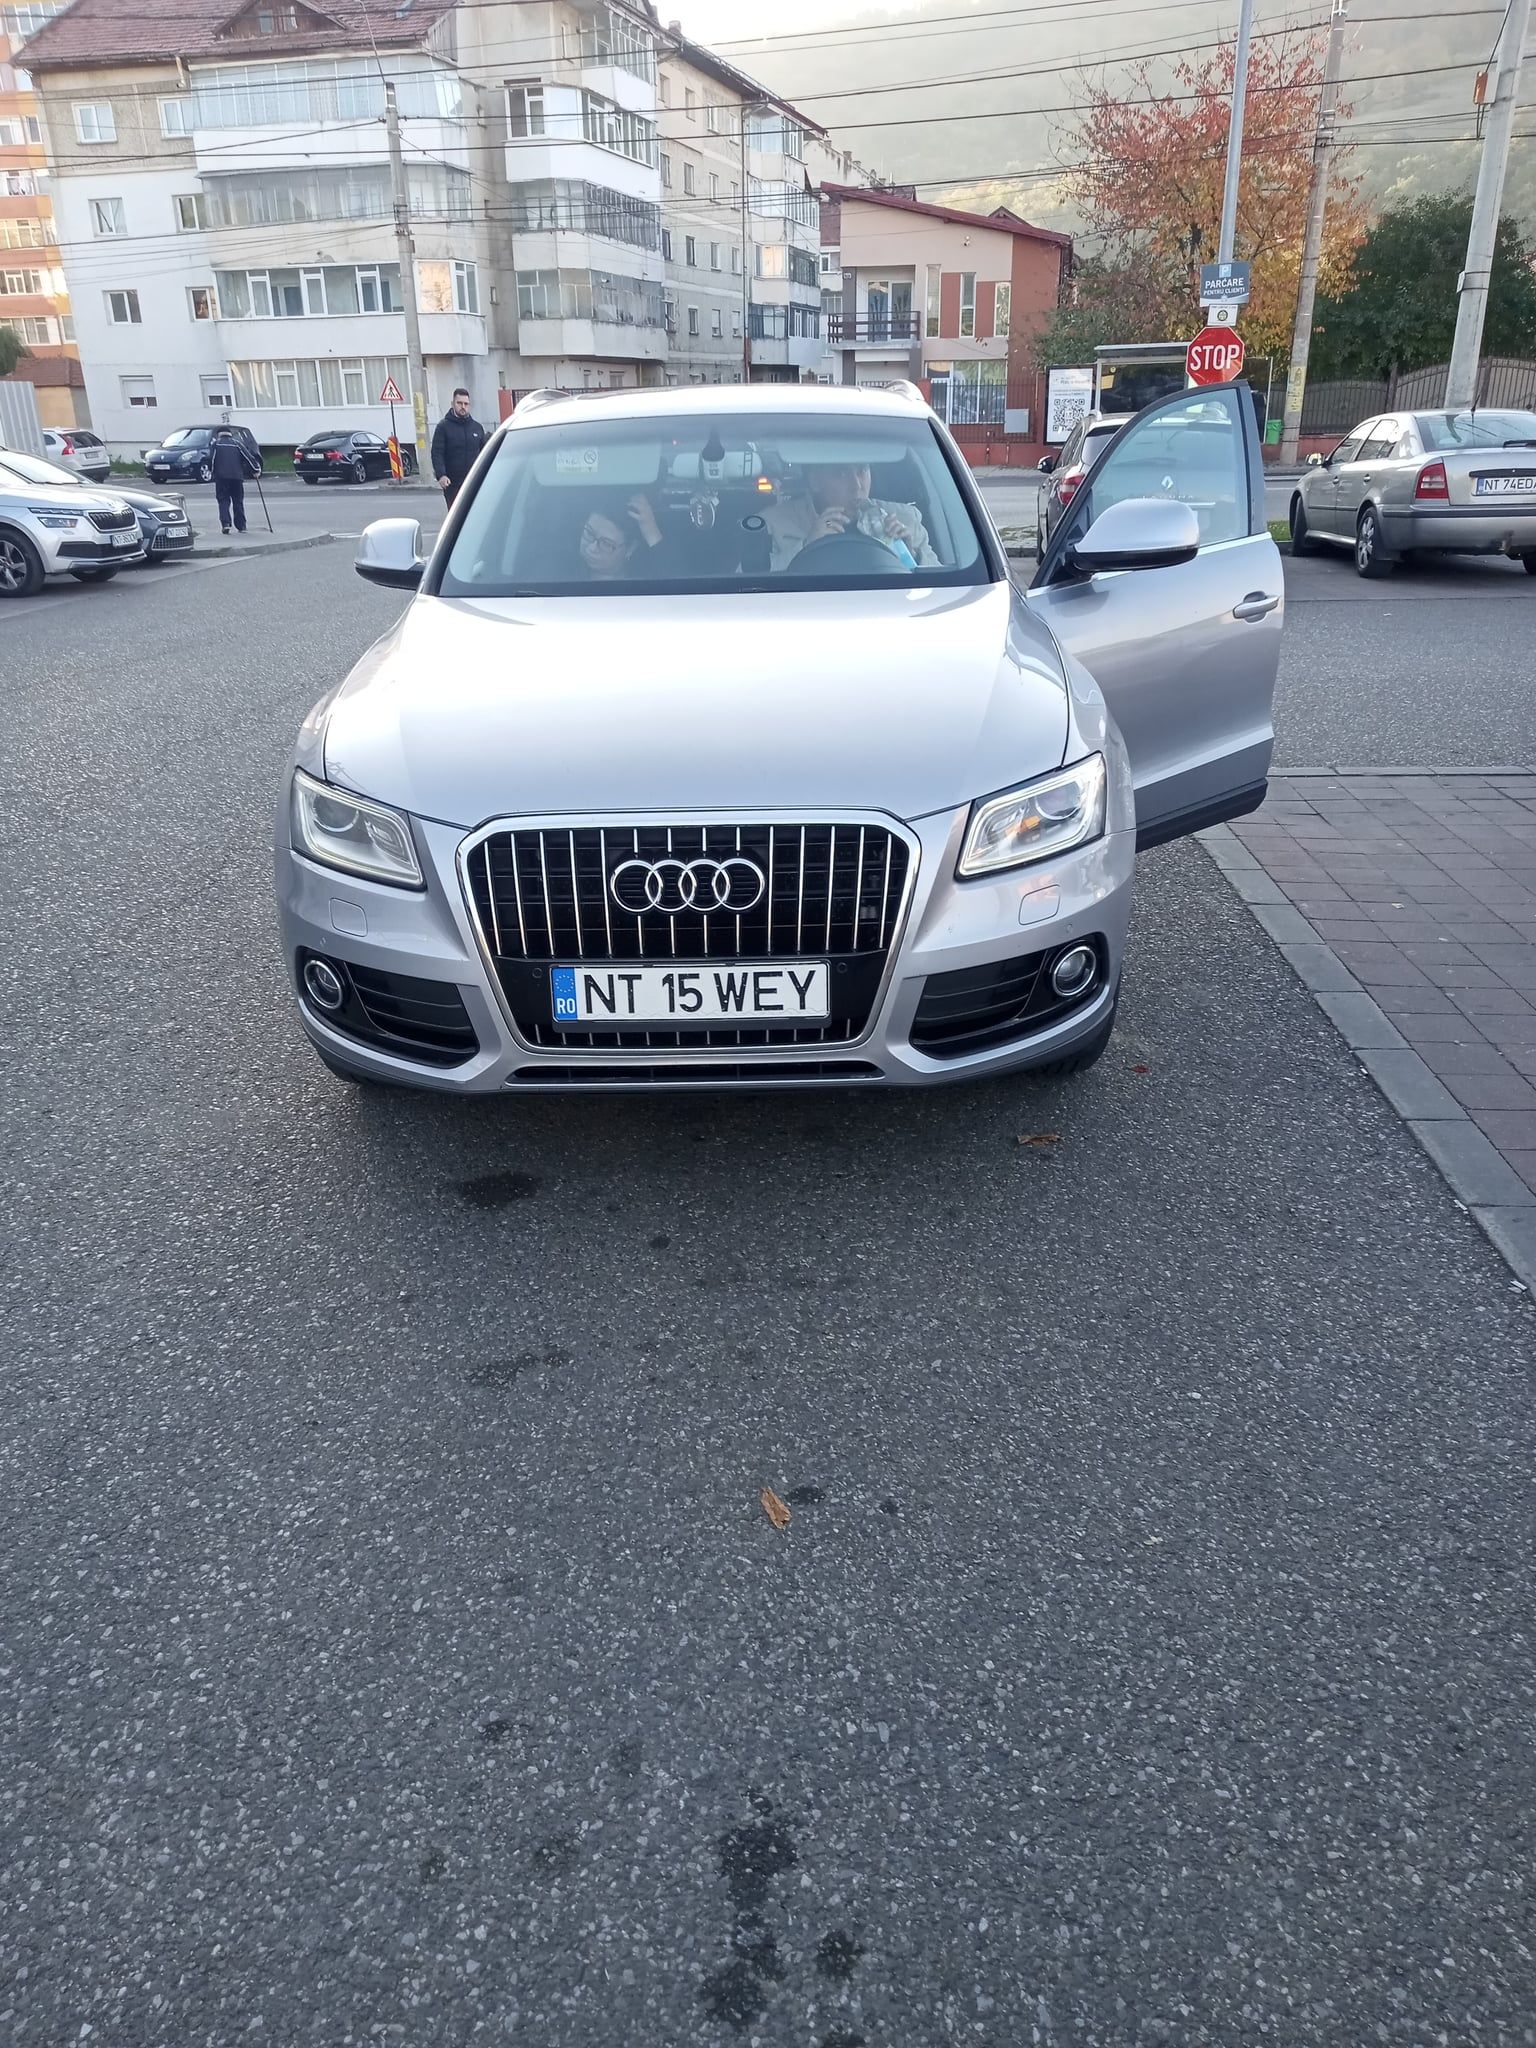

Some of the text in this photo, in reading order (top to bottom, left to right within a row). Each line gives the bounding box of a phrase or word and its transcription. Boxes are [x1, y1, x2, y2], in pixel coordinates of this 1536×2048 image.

[1205, 277, 1244, 289] PARCARE
[1190, 344, 1240, 371] STOP
[1484, 479, 1500, 490] NT
[557, 970, 816, 1014] RO NT 15 WEY
